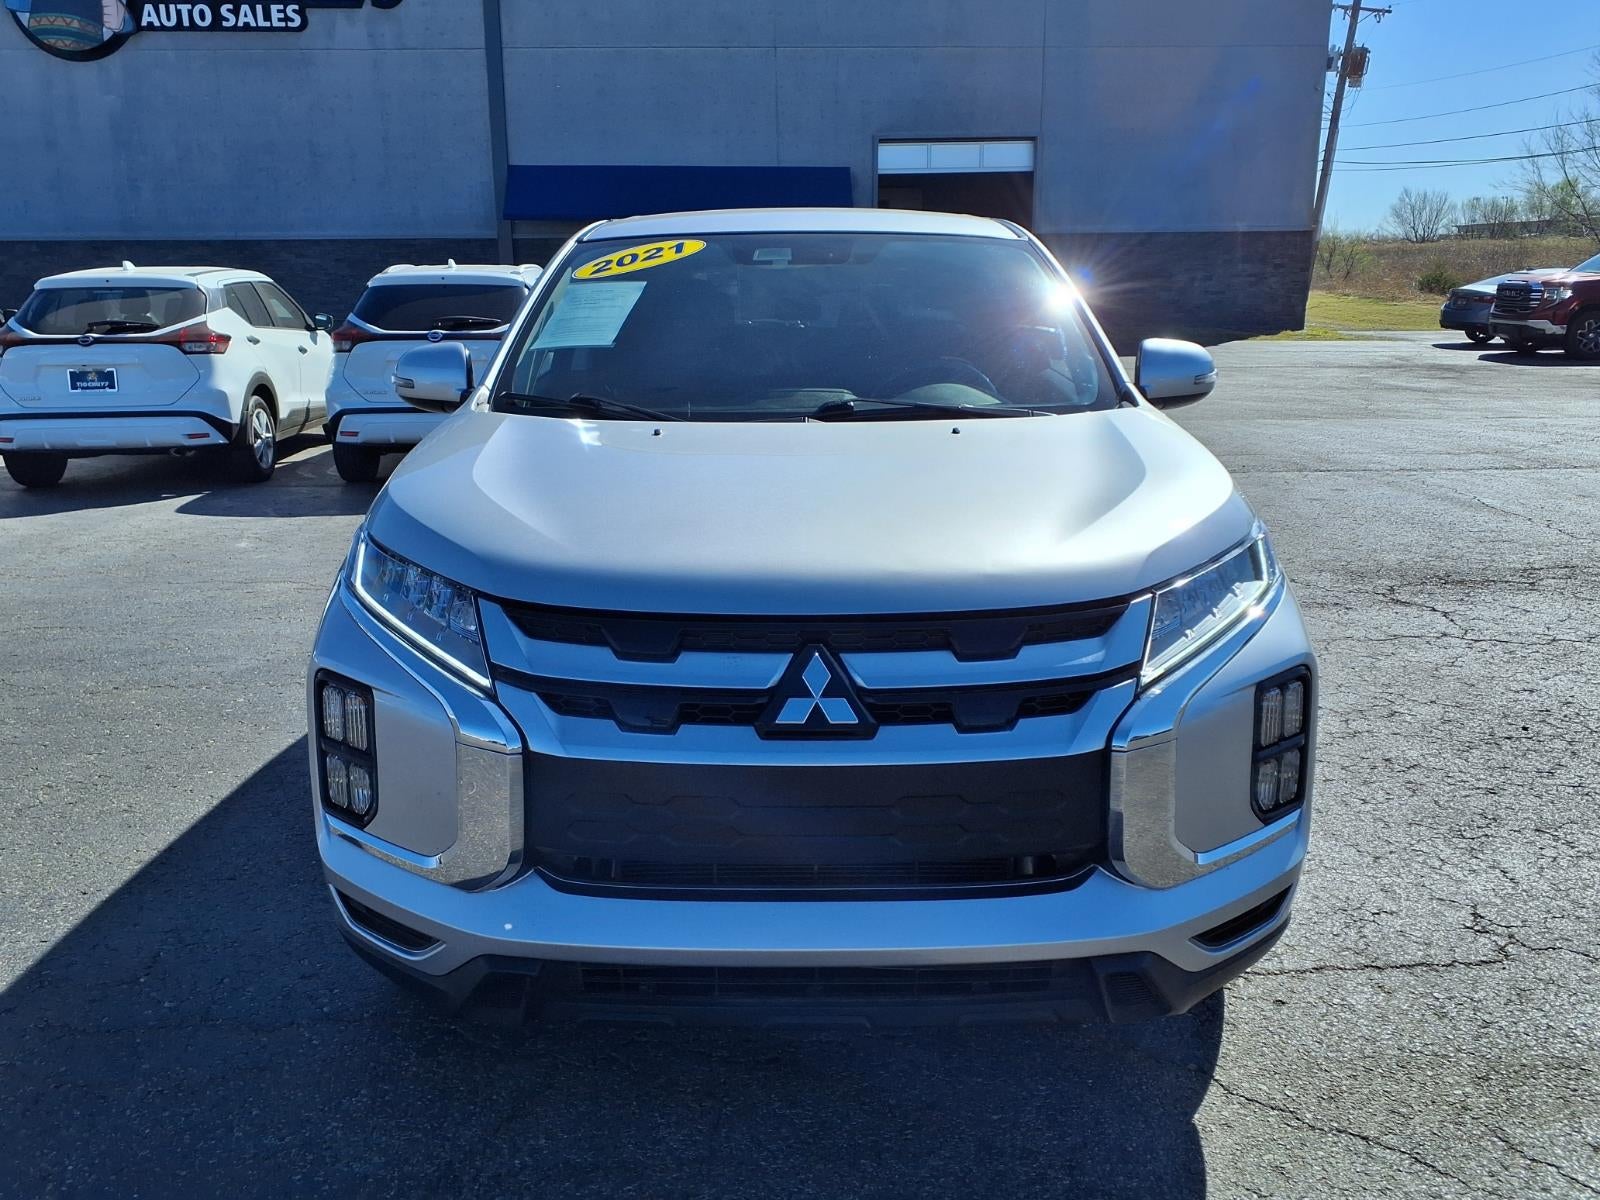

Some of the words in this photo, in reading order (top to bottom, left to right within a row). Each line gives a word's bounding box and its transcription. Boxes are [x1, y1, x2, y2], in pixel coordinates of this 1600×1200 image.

[141, 4, 211, 27] AUTO
[220, 4, 301, 27] SALES
[590, 242, 685, 276] 2021
